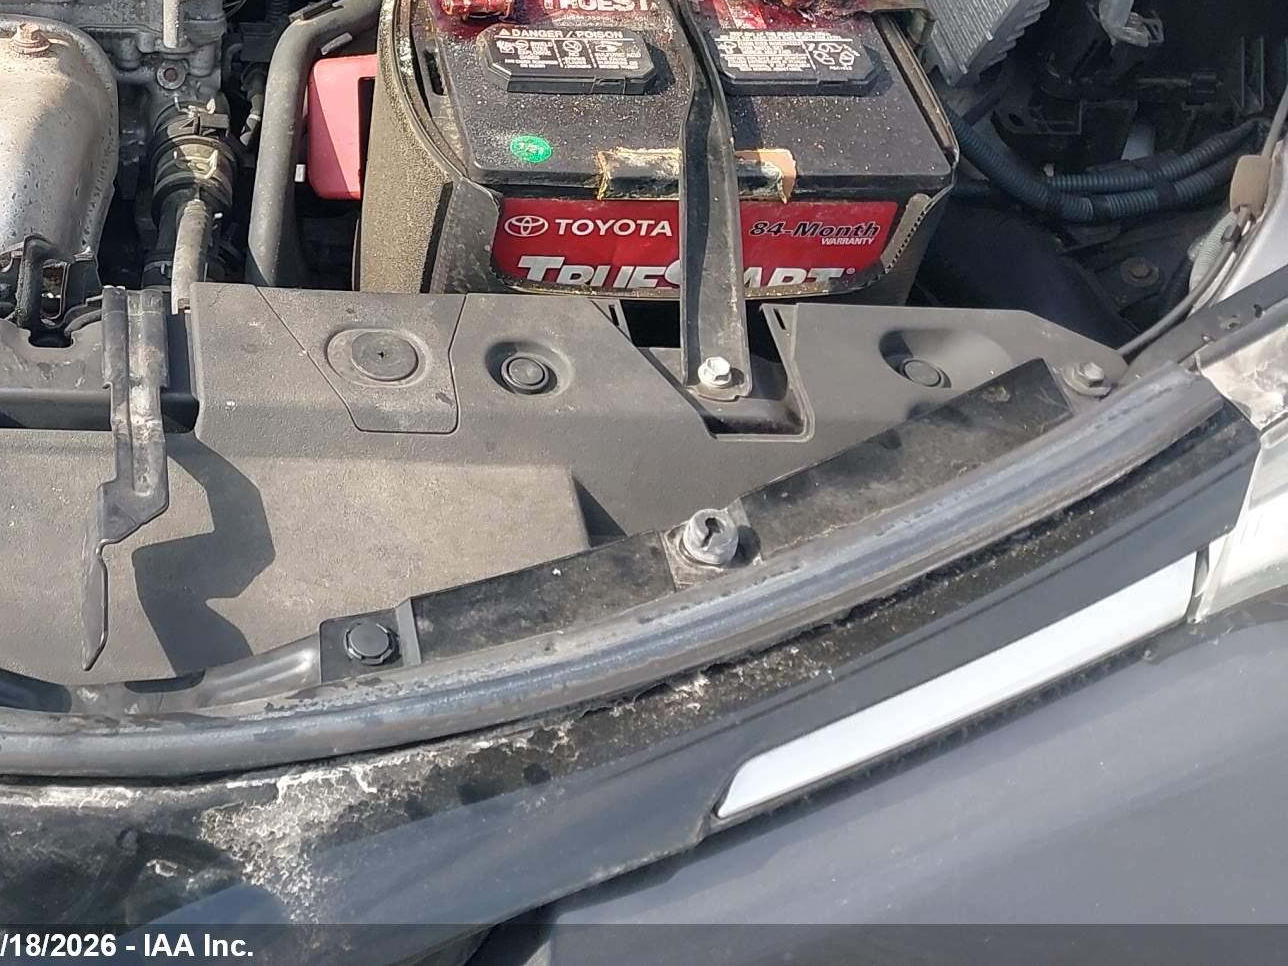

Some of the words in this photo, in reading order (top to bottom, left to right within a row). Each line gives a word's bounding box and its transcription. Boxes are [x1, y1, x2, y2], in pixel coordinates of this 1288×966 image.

[510, 29, 563, 38] DANGER
[577, 30, 624, 39] POISON
[554, 218, 673, 237] TOYOTA
[749, 220, 881, 238] 84-Month
[820, 237, 875, 246] WARRANTY
